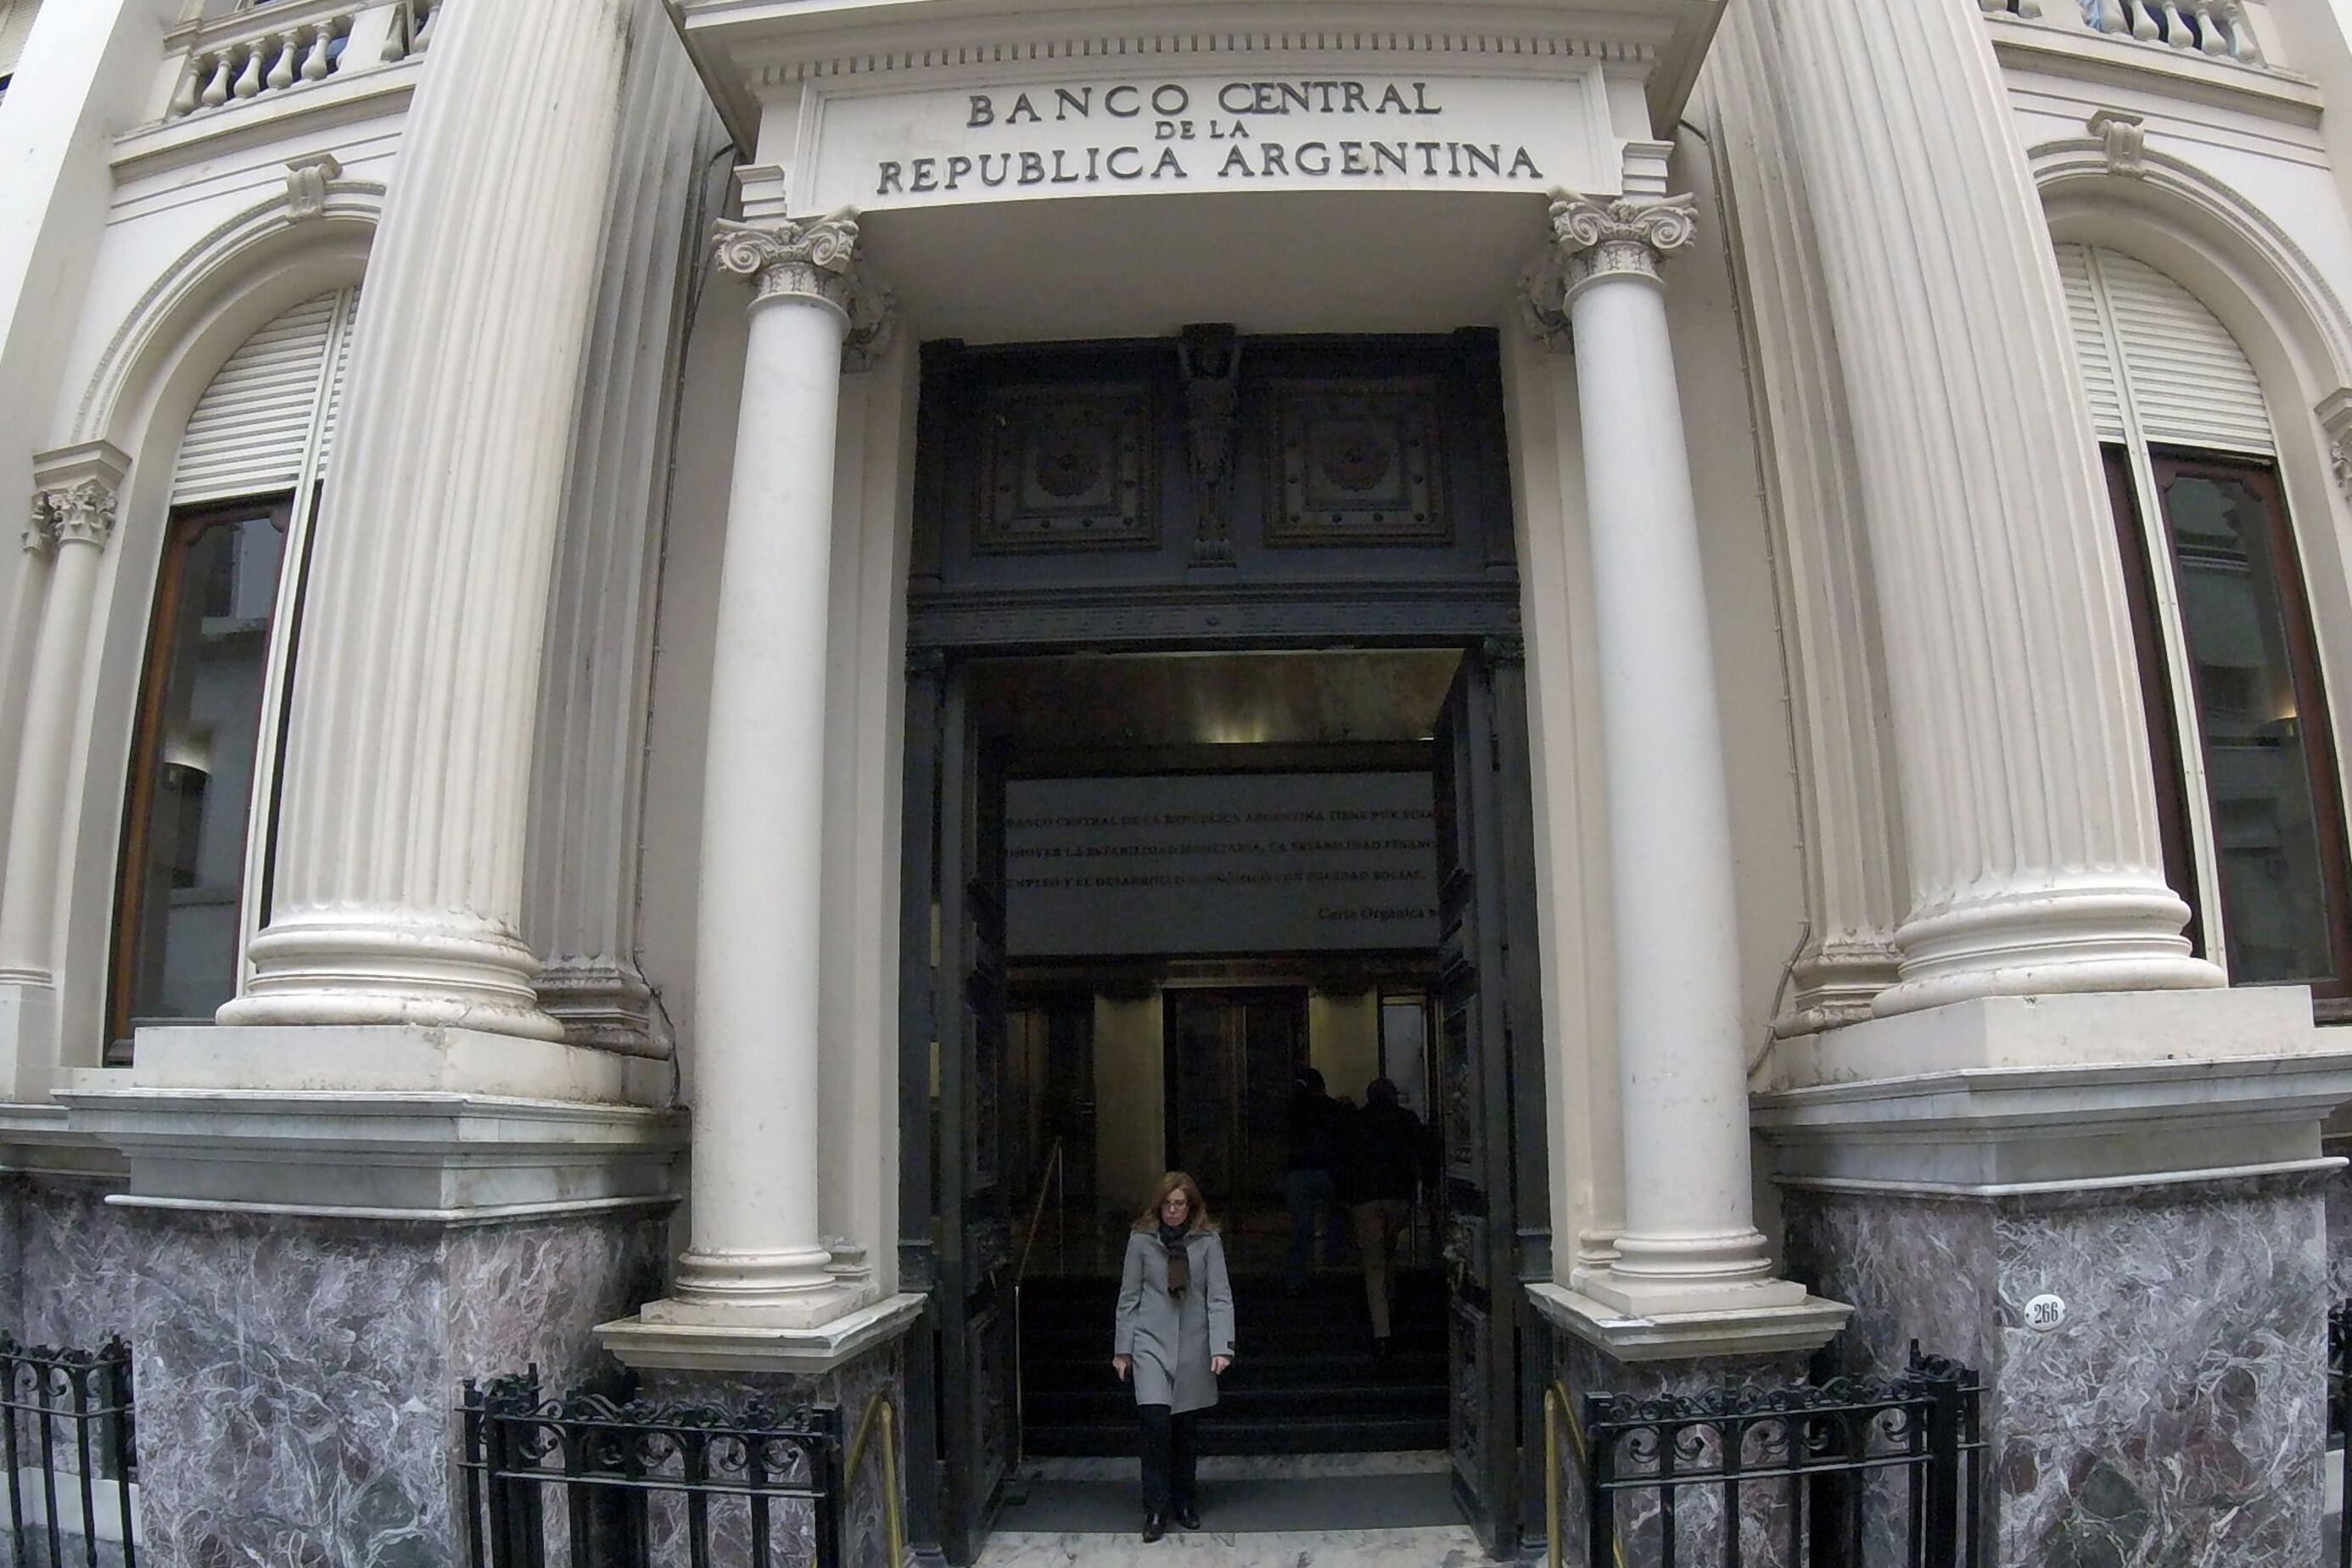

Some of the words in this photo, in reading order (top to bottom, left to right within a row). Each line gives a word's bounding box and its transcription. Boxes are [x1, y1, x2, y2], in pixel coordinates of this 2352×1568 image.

[966, 84, 1189, 128] BANCO
[1218, 81, 1442, 115] CENTRAL
[1155, 120, 1196, 140] DE
[1209, 120, 1249, 139] LA
[876, 146, 1188, 194] REPUBLICA
[1218, 141, 1543, 178] ARGENTINA
[2034, 1302, 2058, 1324] 266
